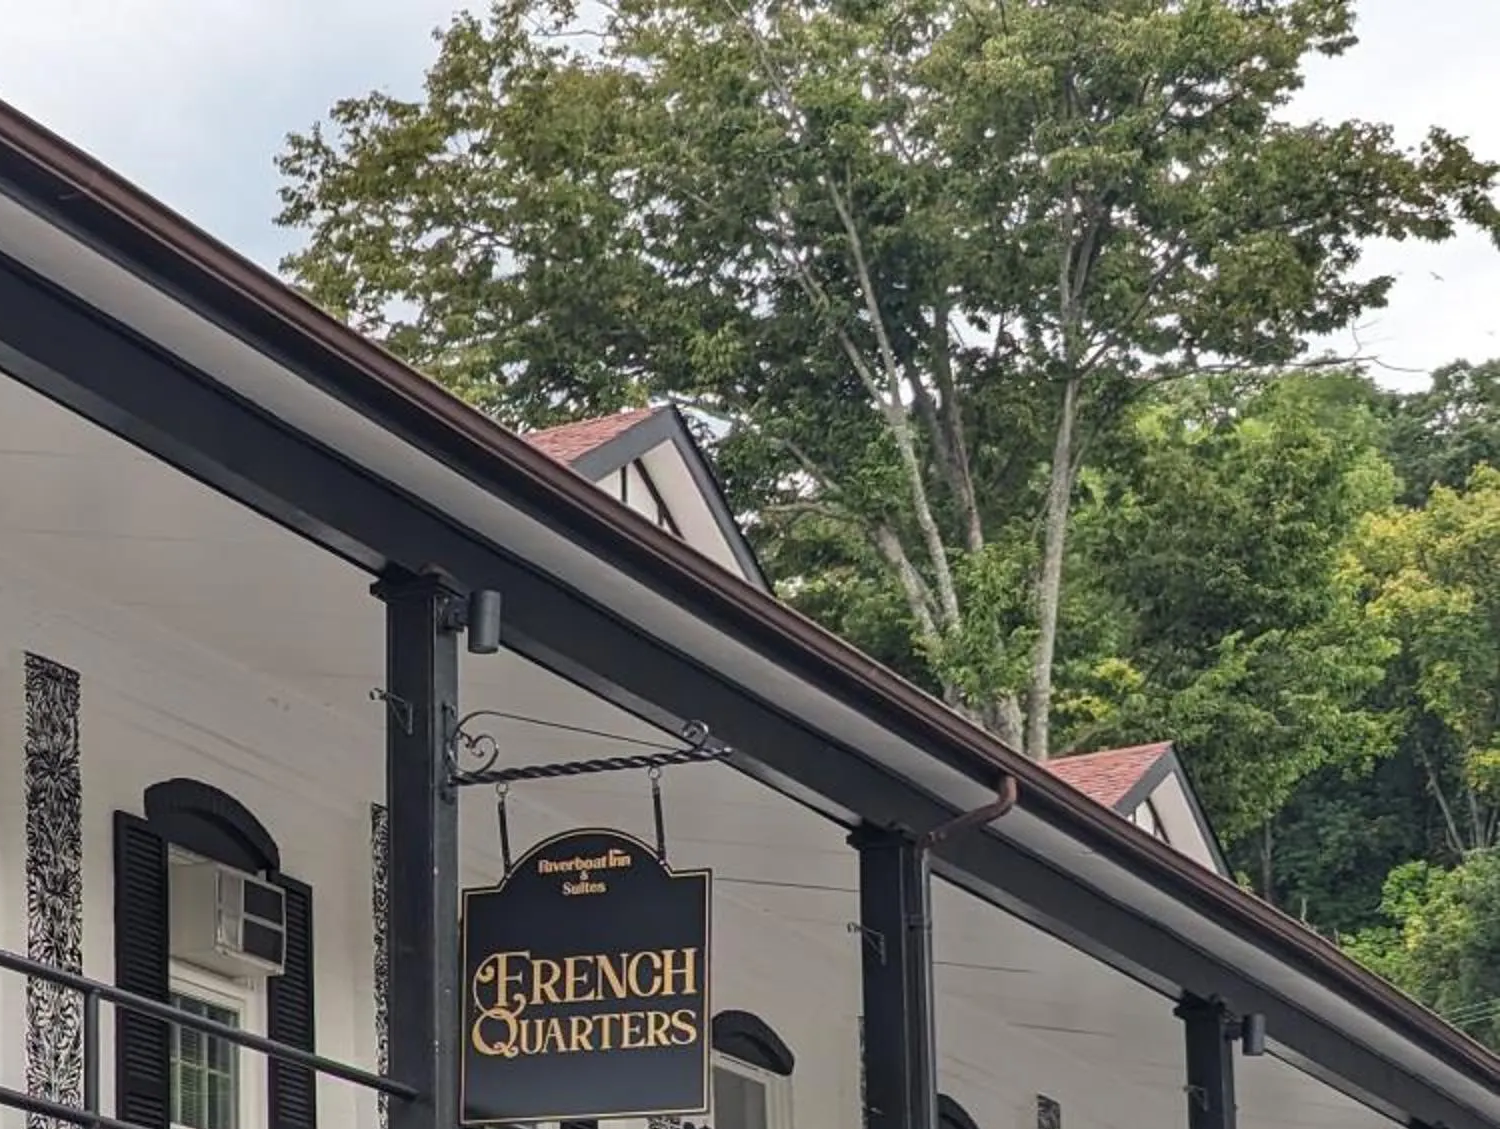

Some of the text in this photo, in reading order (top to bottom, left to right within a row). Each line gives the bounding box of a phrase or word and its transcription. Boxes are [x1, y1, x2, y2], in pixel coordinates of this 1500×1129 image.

[608, 848, 631, 868] Inn
[472, 947, 699, 1018] FRENCH
[471, 1007, 698, 1058] QUARTERS
